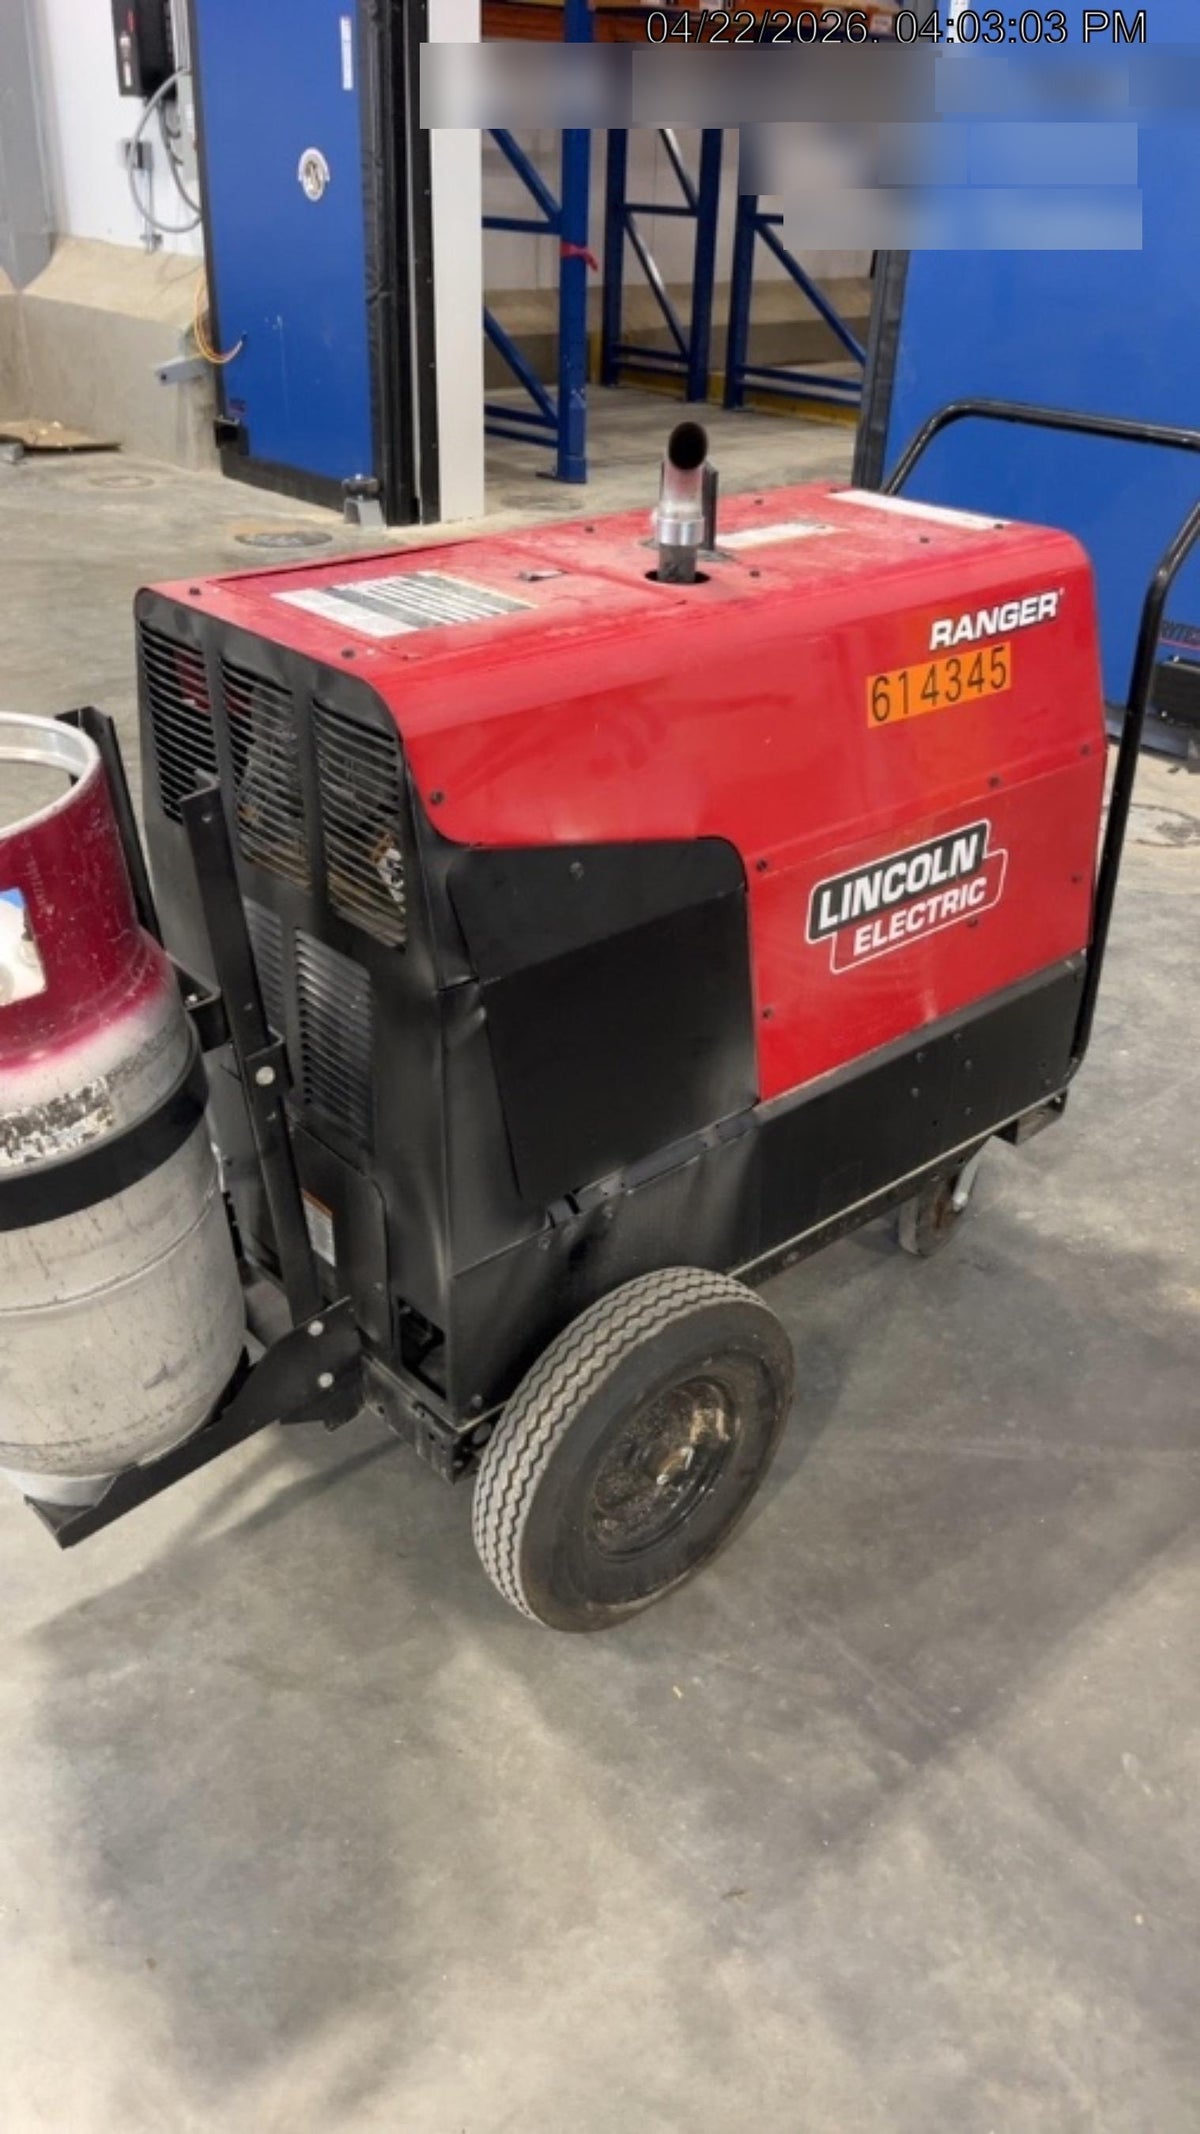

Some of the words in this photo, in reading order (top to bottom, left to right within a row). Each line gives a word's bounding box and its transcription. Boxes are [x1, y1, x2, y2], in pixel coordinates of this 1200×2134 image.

[929, 592, 1058, 650] RANGER
[871, 647, 1006, 721] 614345
[818, 834, 979, 930] LINCOLN
[853, 877, 987, 956] ELECTRIC
